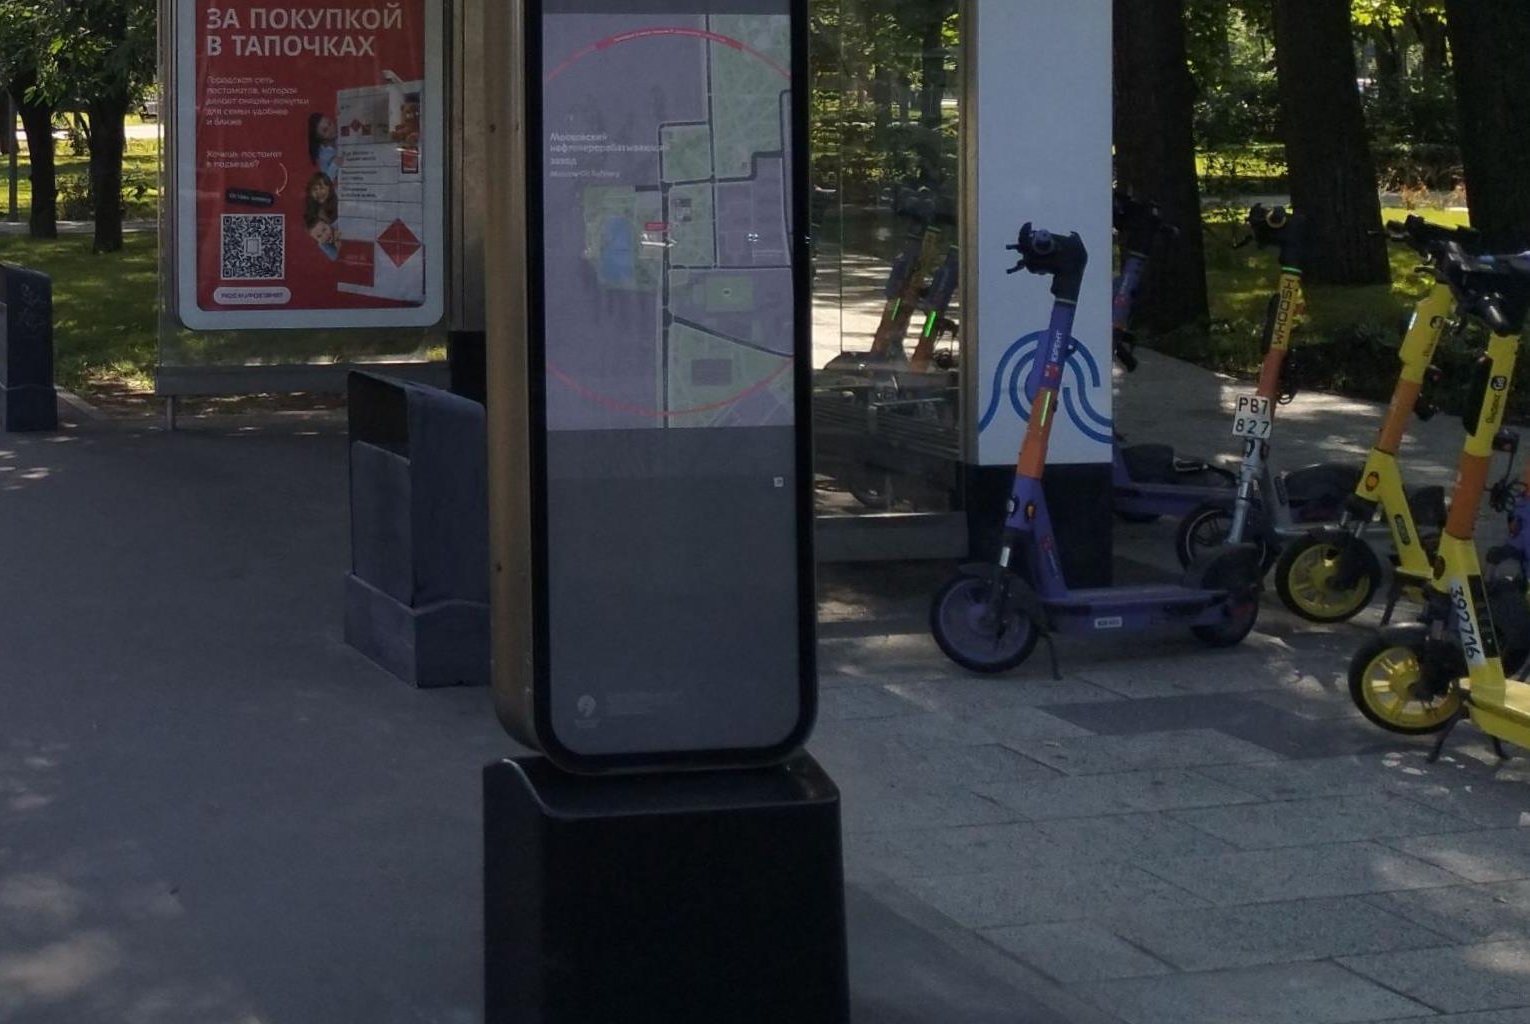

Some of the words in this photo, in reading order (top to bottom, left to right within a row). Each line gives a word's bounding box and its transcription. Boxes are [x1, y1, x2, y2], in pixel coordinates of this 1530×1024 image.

[205, 7, 240, 30] ЗА
[249, 1, 403, 30] ПОКУПКОЙ
[206, 34, 223, 57] В
[230, 34, 375, 57] ТАПОЧКАХ
[1273, 278, 1295, 345] WHOOSH
[1234, 417, 1270, 435] 827
